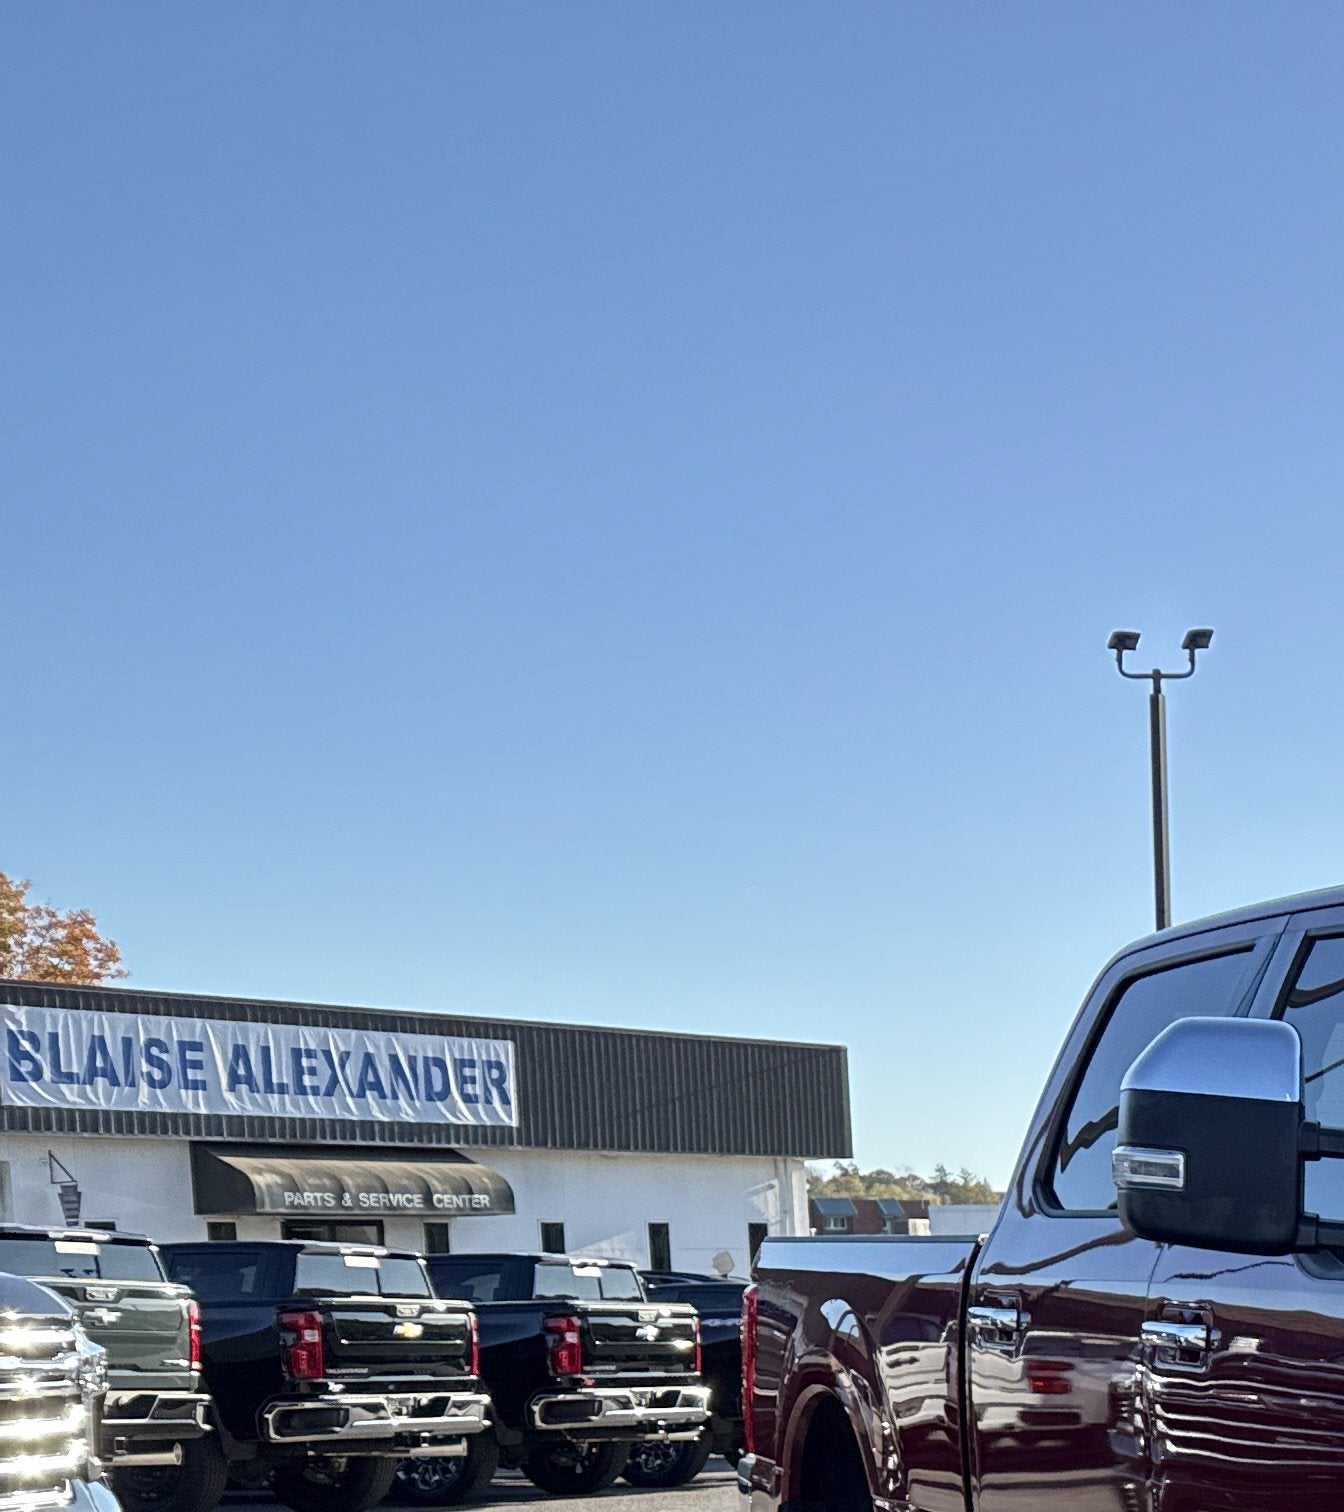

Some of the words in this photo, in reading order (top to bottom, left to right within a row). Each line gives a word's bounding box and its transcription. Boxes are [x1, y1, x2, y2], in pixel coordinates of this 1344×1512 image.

[5, 1028, 207, 1091] BLAISE
[225, 1043, 511, 1105] ALEXANDER
[284, 1191, 335, 1206] PARTS
[341, 1193, 353, 1207] &
[359, 1193, 424, 1208] SERVICE
[433, 1194, 490, 1209] CENTER
